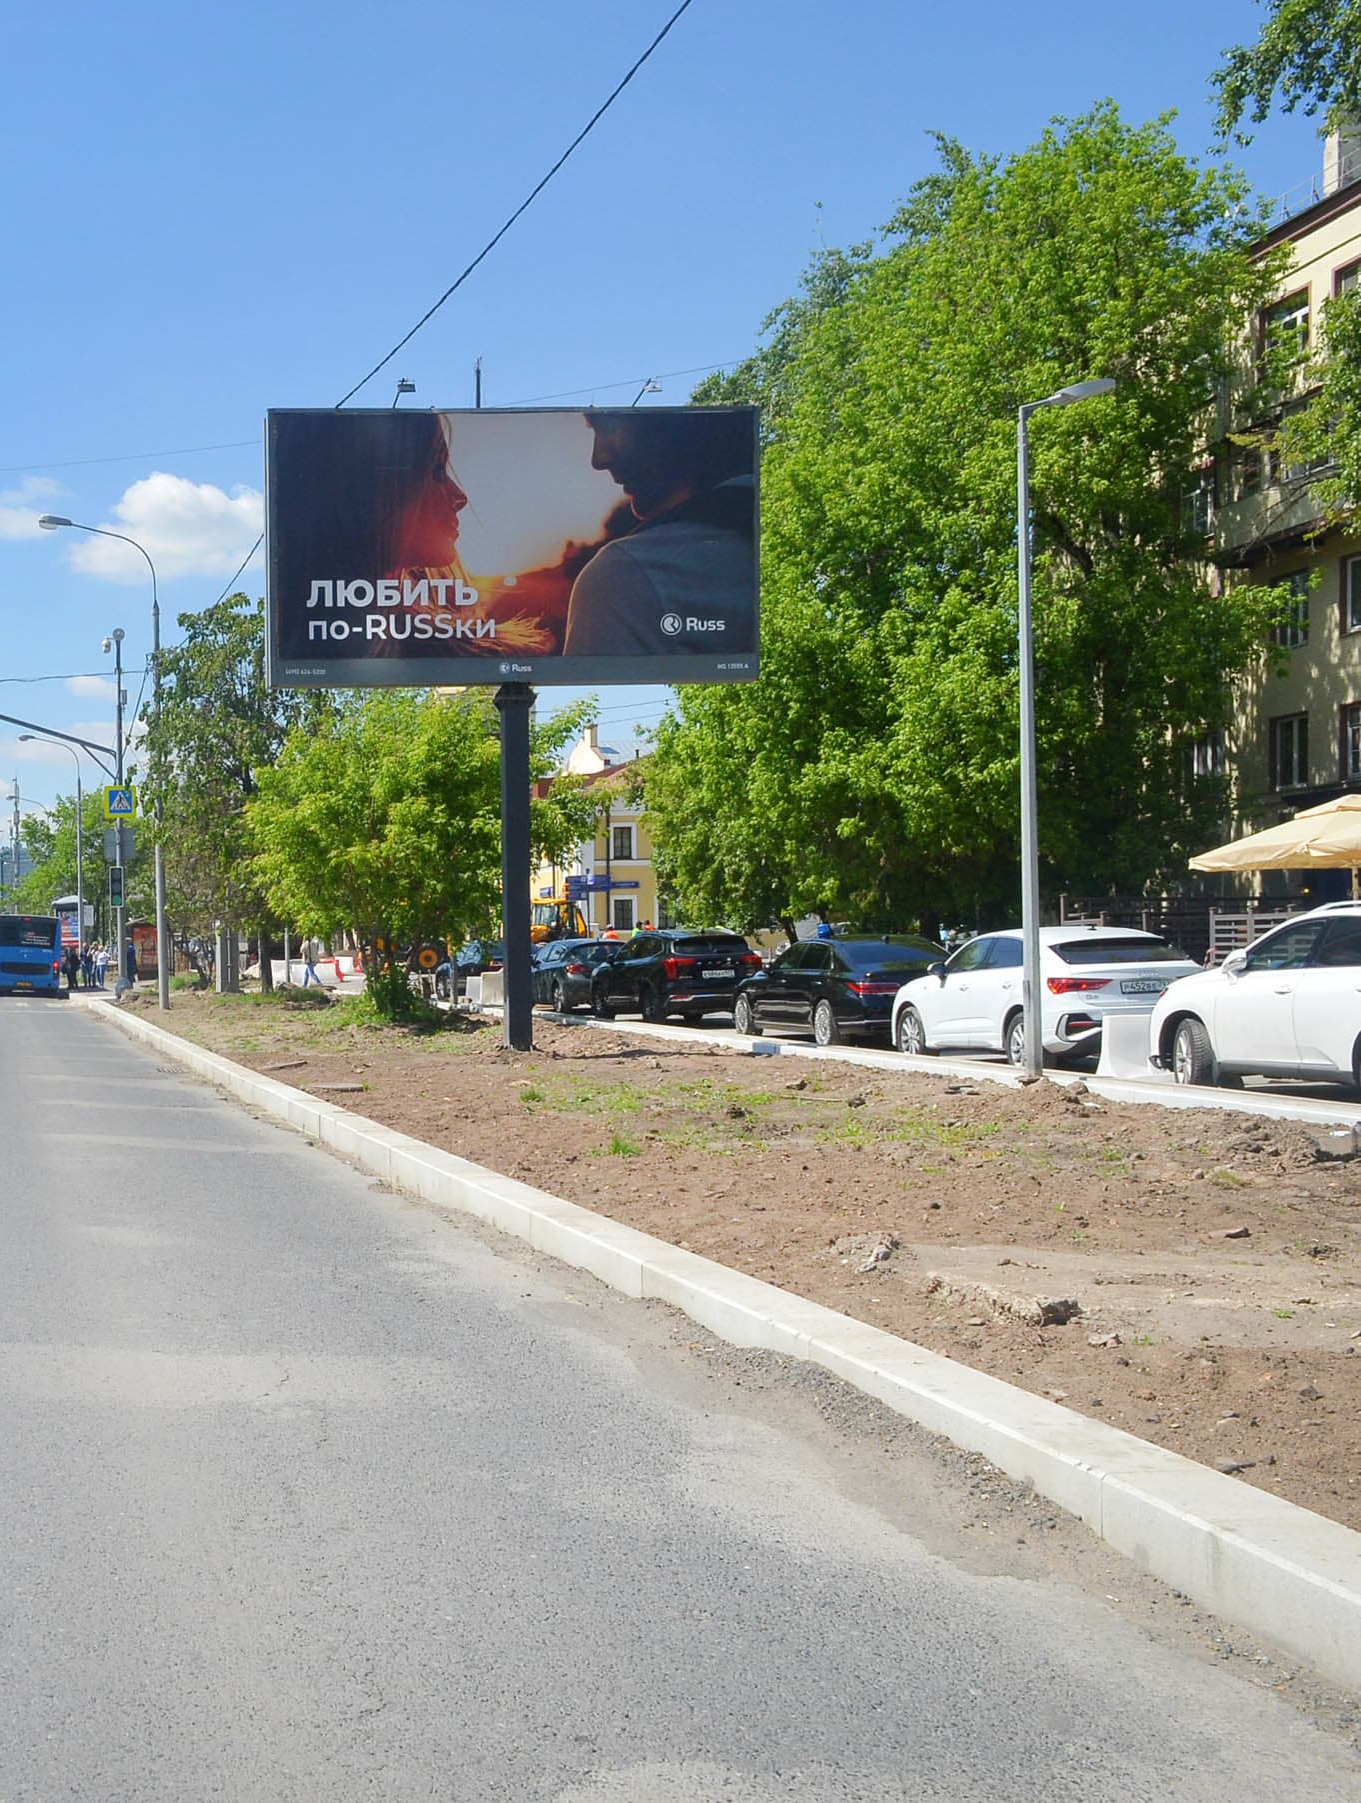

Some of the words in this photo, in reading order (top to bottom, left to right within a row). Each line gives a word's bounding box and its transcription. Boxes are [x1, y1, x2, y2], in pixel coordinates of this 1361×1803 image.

[306, 578, 479, 608] ЛЮБИТЬ
[308, 614, 496, 641] по-RUSSки
[685, 616, 726, 632] Russ
[511, 663, 533, 672] Russ
